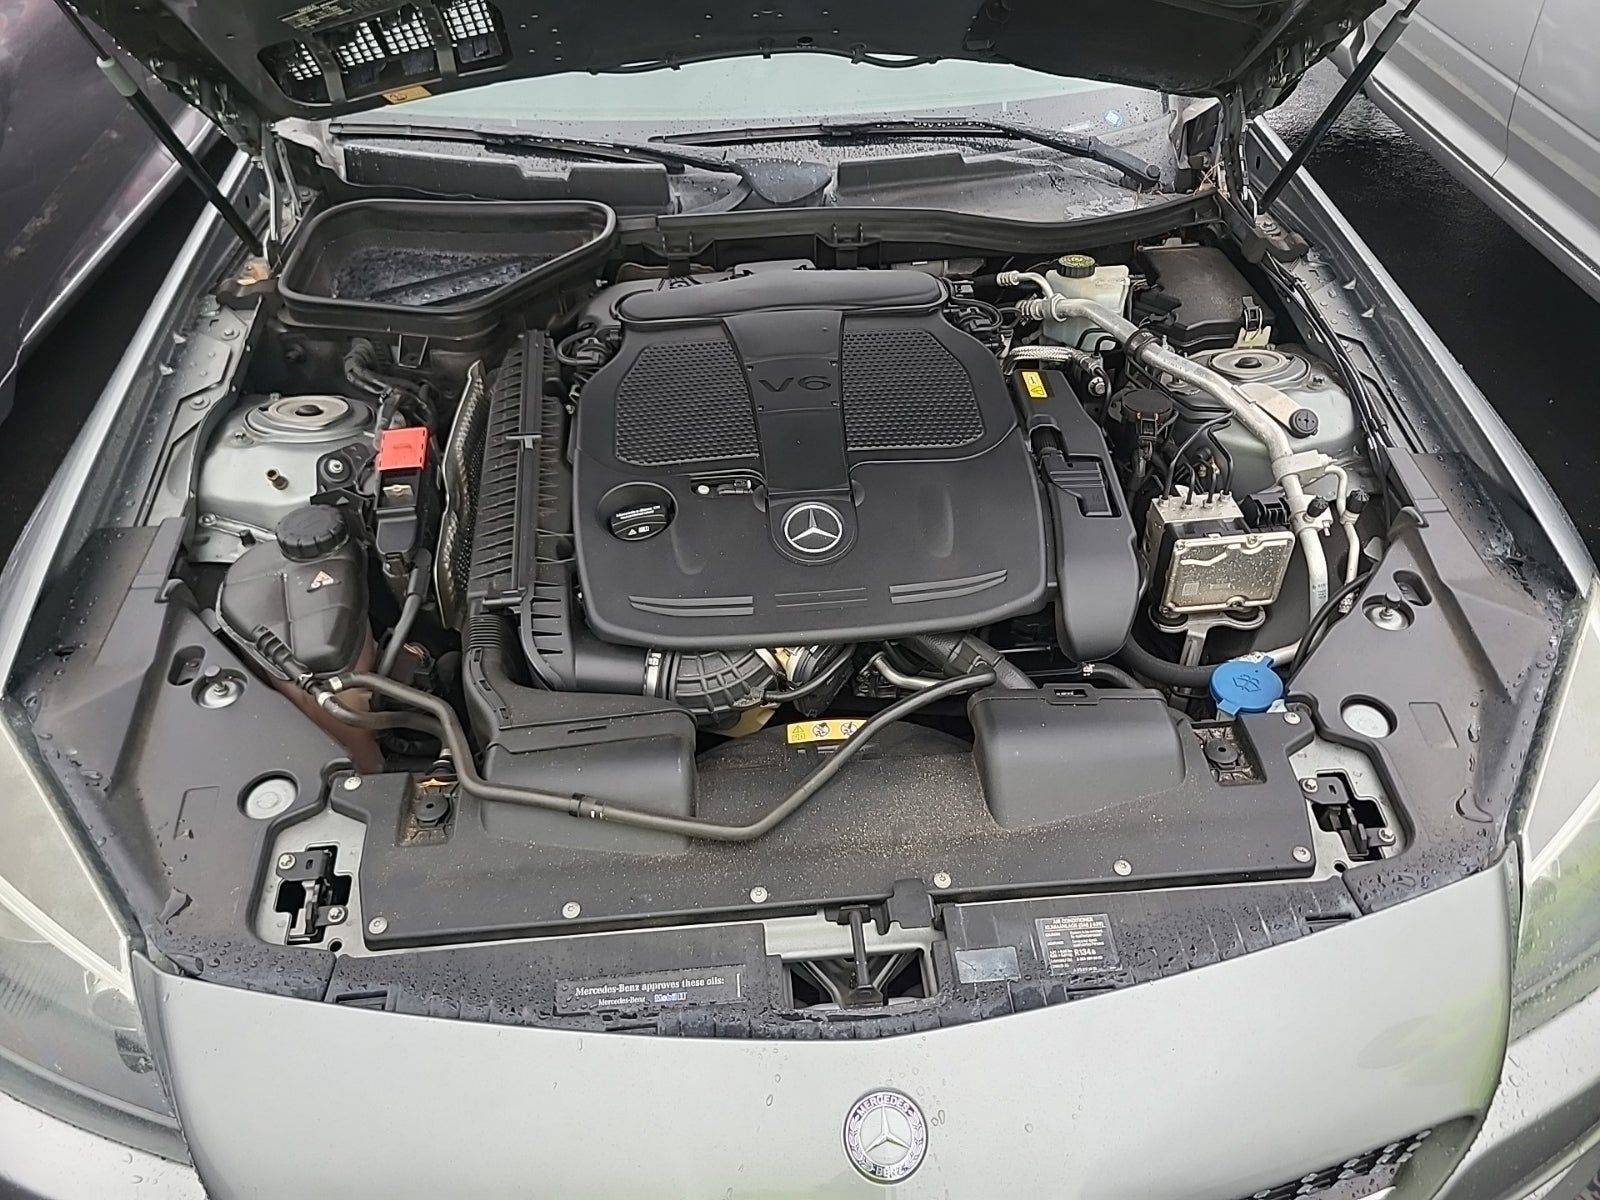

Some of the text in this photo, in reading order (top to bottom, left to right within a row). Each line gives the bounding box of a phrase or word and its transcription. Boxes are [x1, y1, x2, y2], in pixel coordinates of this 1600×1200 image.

[759, 375, 831, 392] V6
[575, 983, 640, 996] Mercedes-Benz
[641, 981, 680, 993] approves
[682, 978, 704, 988] these
[598, 996, 646, 1006] Mercedes-Benz
[857, 1094, 910, 1117] MERCEDES
